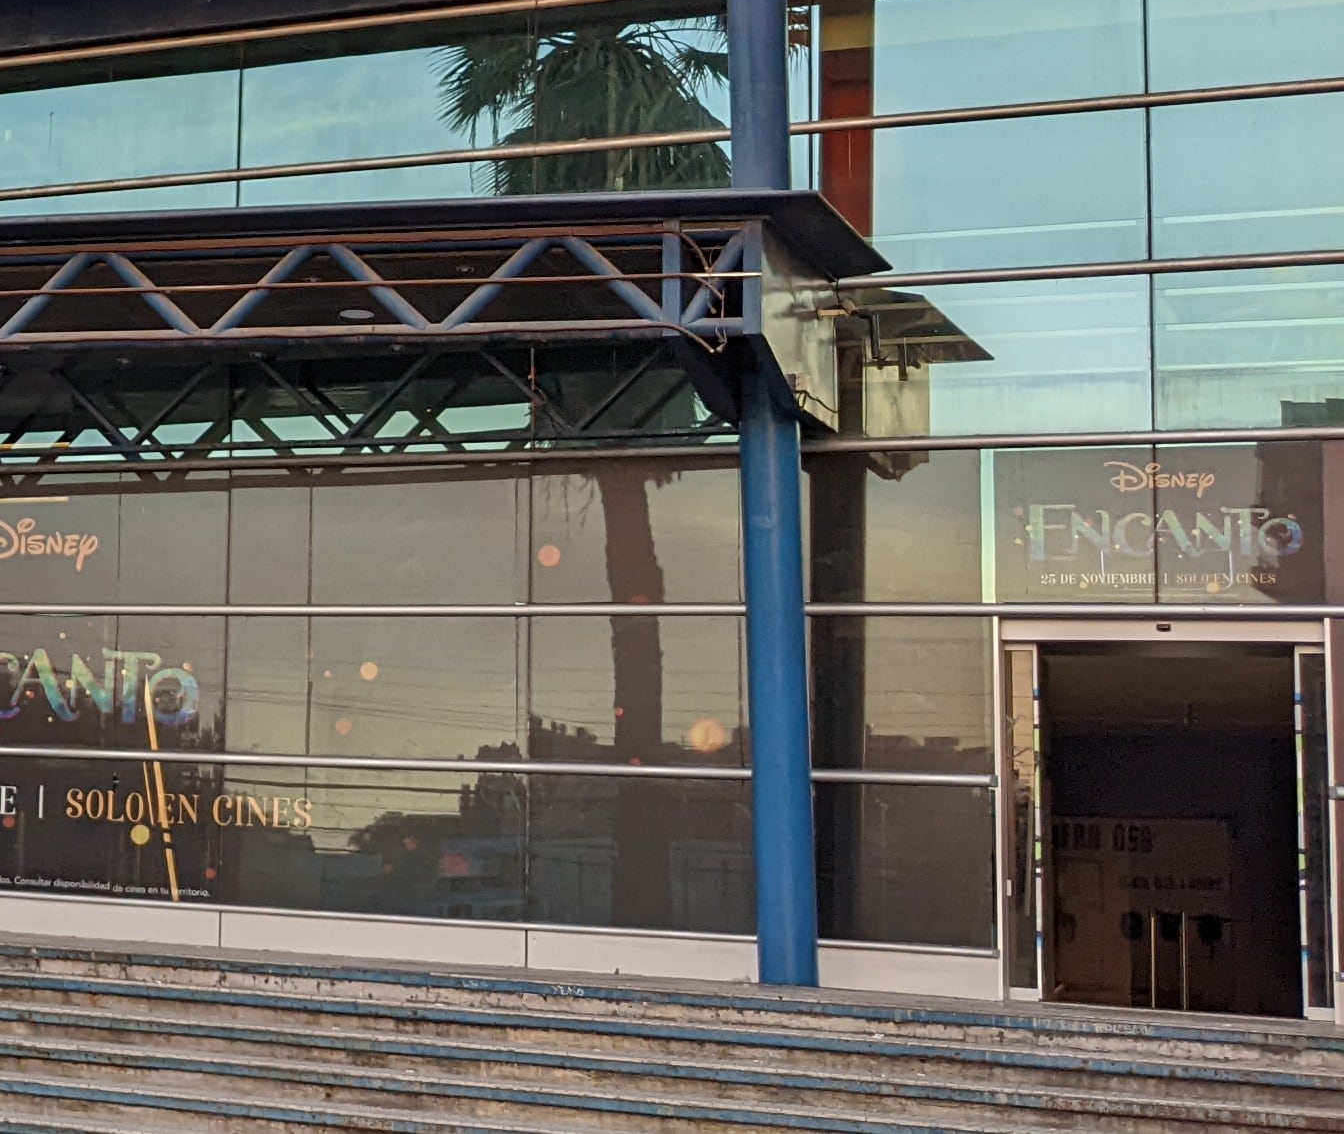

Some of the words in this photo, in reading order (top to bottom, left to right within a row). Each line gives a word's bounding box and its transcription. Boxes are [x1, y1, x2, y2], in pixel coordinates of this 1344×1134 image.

[1104, 461, 1215, 498] Disney
[1029, 504, 1305, 560] ENCANTO
[1040, 573, 1056, 584] 25
[1060, 573, 1076, 584] DE
[1081, 572, 1155, 584] NOVIEMBRE
[1236, 572, 1277, 584] CINES
[66, 788, 145, 823] SOLO
[158, 793, 200, 824] EN
[212, 794, 312, 828] CINES
